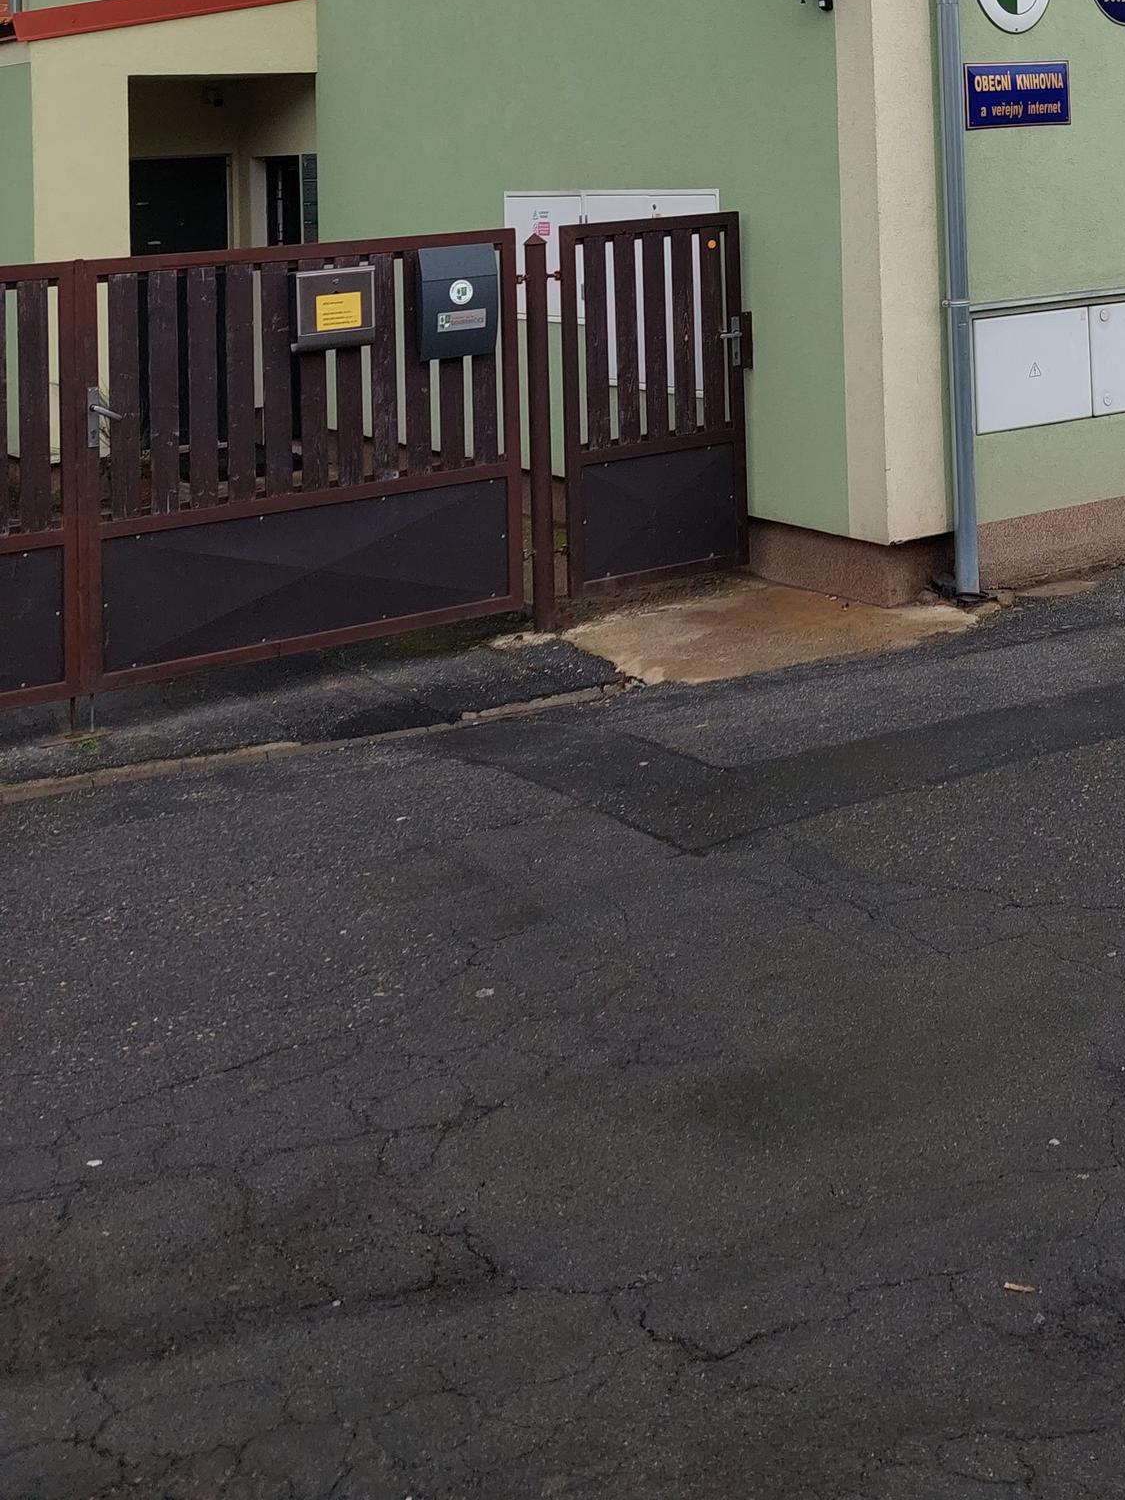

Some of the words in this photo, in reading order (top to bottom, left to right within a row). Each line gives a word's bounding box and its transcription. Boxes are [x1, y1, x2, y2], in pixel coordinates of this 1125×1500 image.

[974, 70, 1012, 92] OBECNÍ
[1015, 72, 1064, 90] KNIHOVNA
[980, 106, 987, 117] a
[991, 102, 1024, 118] veřejný
[1028, 100, 1061, 115] internet
